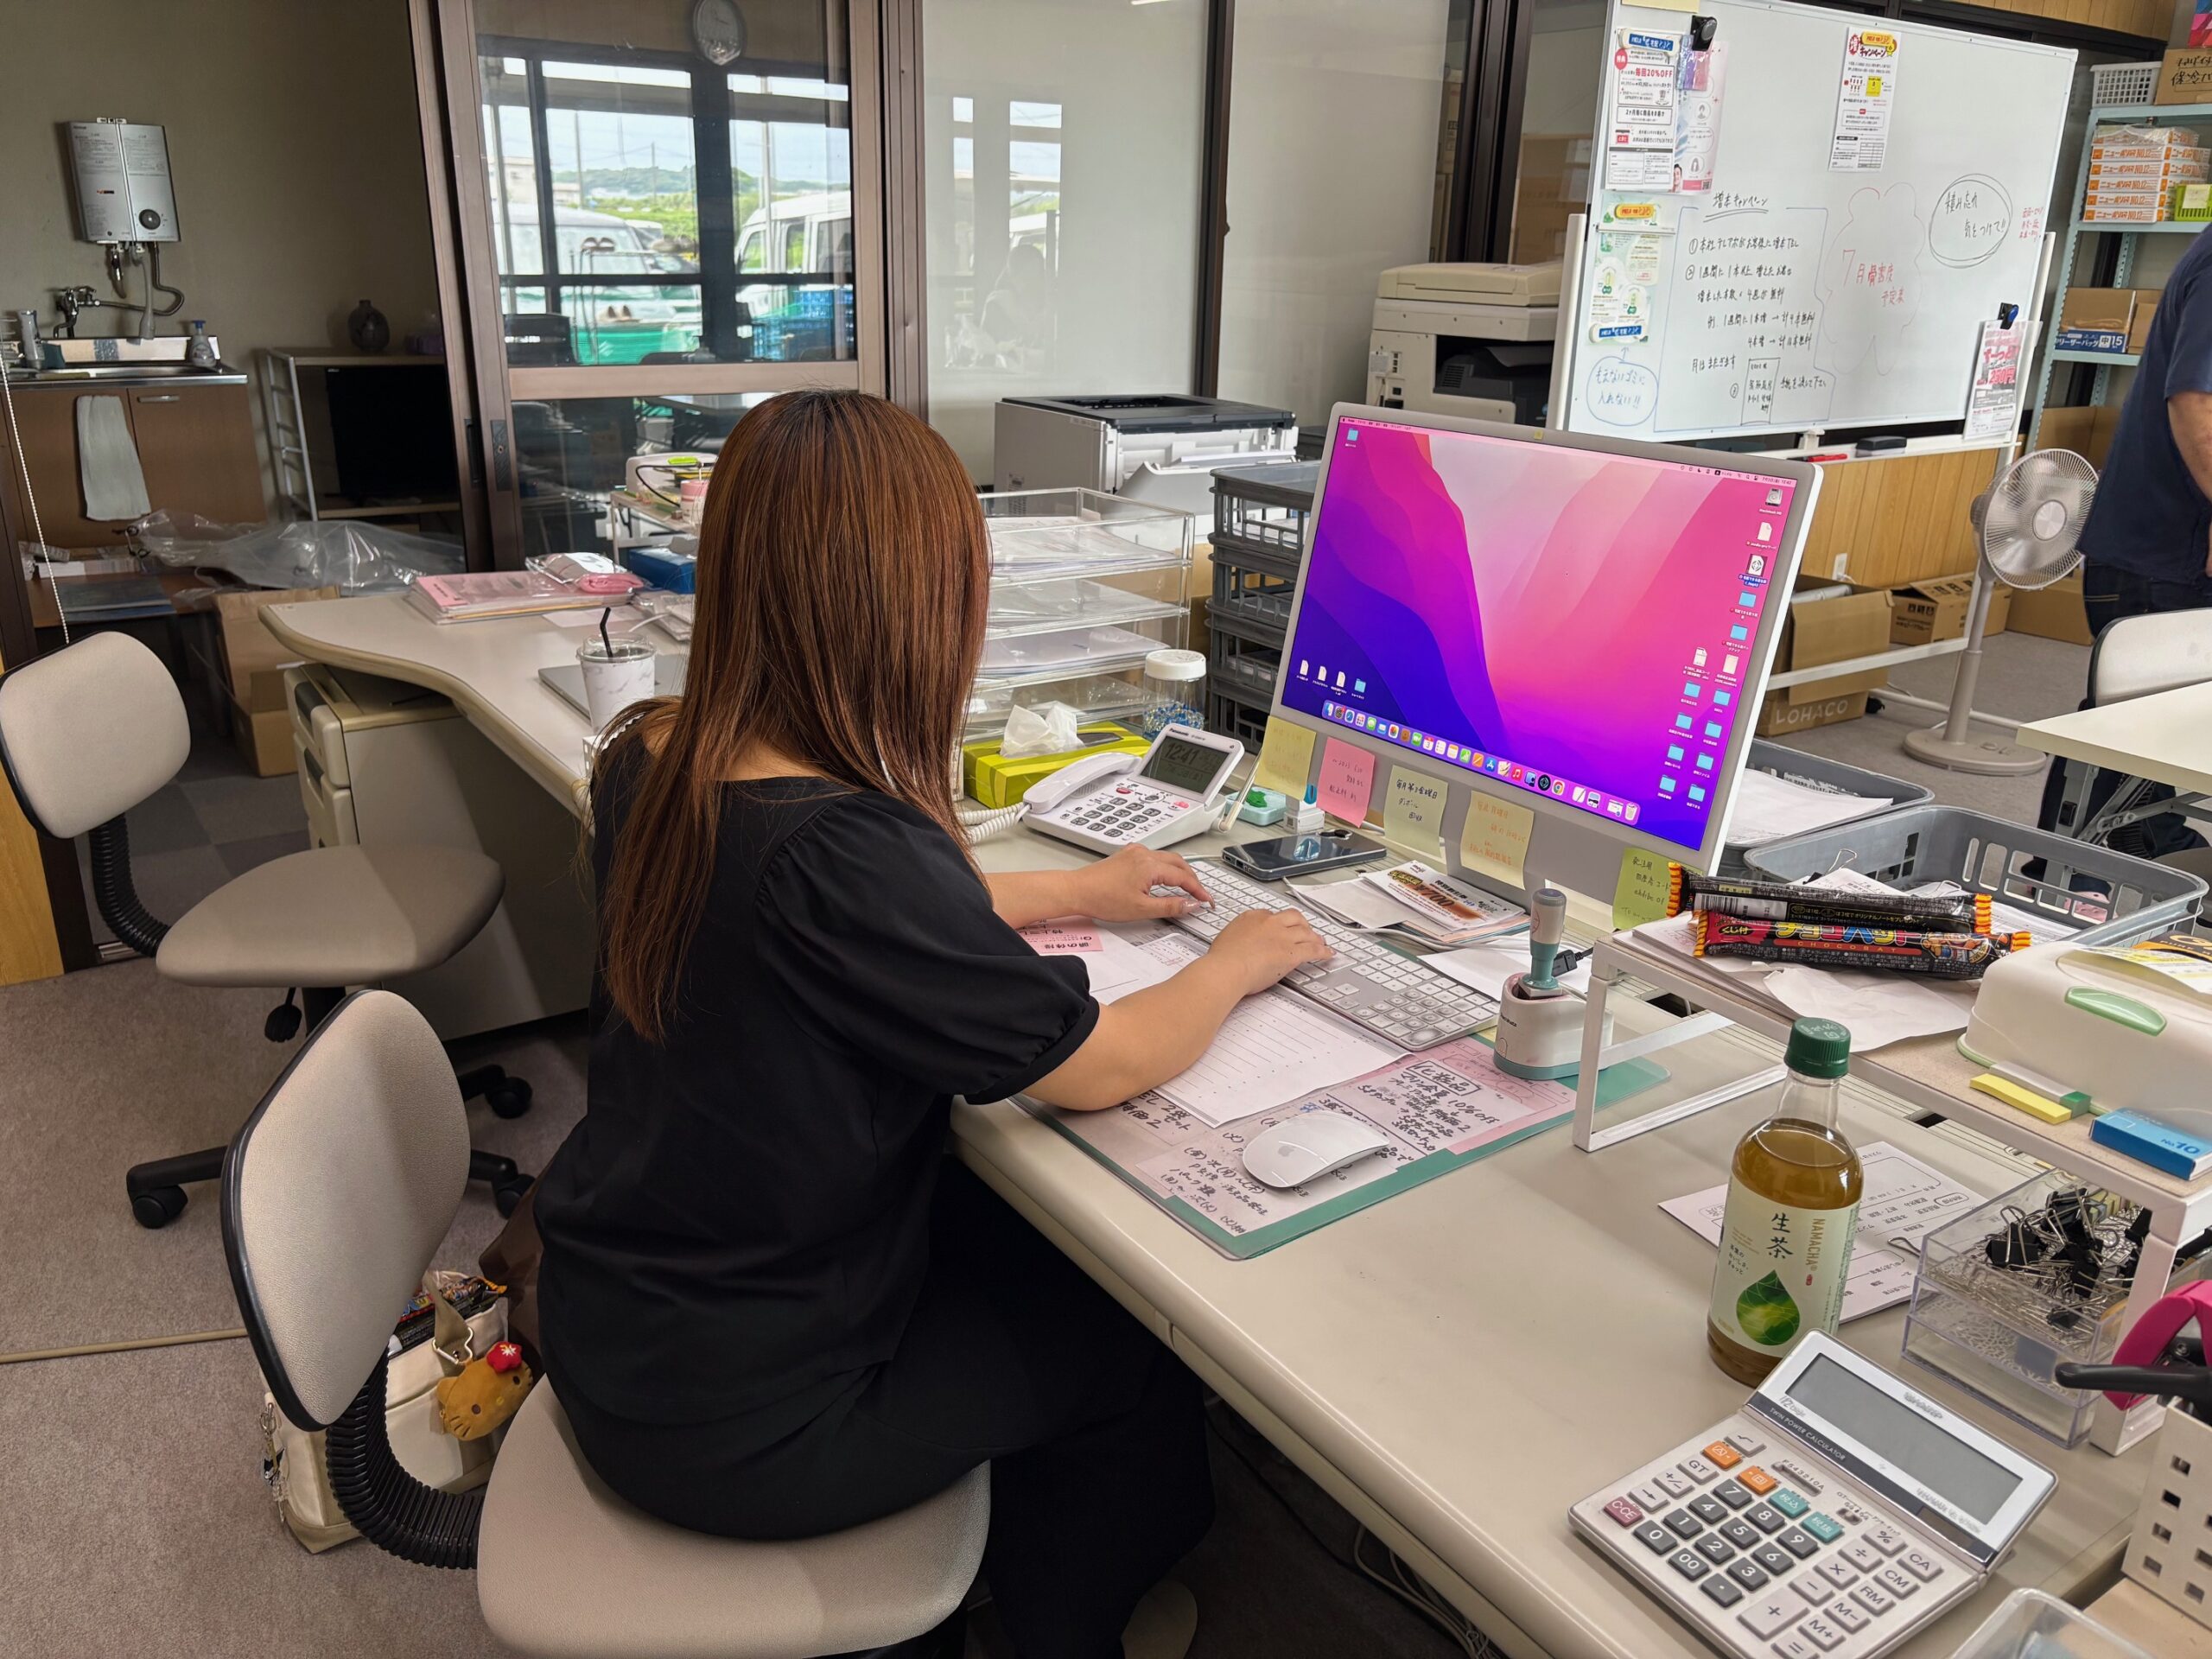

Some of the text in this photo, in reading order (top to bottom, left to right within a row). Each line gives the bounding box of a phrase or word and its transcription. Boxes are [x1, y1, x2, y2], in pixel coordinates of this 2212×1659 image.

[2111, 335, 2123, 346] 15
[1776, 699, 1850, 725] LOHACO
[1165, 742, 1200, 766] 12:41
[1722, 926, 1750, 936] くじ付
[1797, 940, 1897, 953] CHOCOBAT
[1765, 1212, 1794, 1259] 生茶
[1805, 1217, 1826, 1266] NAMACHA
[1770, 1408, 1847, 1461] TWIN POWER CALCULATOR
[1688, 1459, 1709, 1474] GT
[1726, 1486, 1740, 1496] 7
[1703, 1503, 1717, 1512] 4
[1758, 1510, 1771, 1521] 8
[1649, 1529, 1662, 1541] 0
[1733, 1526, 1749, 1536] 5
[1790, 1535, 1805, 1545] 9
[1707, 1541, 1723, 1553] 2
[1678, 1554, 1700, 1569] 00
[1766, 1553, 1782, 1562] 6
[1909, 1553, 1931, 1572] CA
[1741, 1567, 1757, 1578] 3
[1885, 1569, 1910, 1588] CM
[1859, 1586, 1885, 1605] RM
[1808, 1618, 1834, 1639] M+
